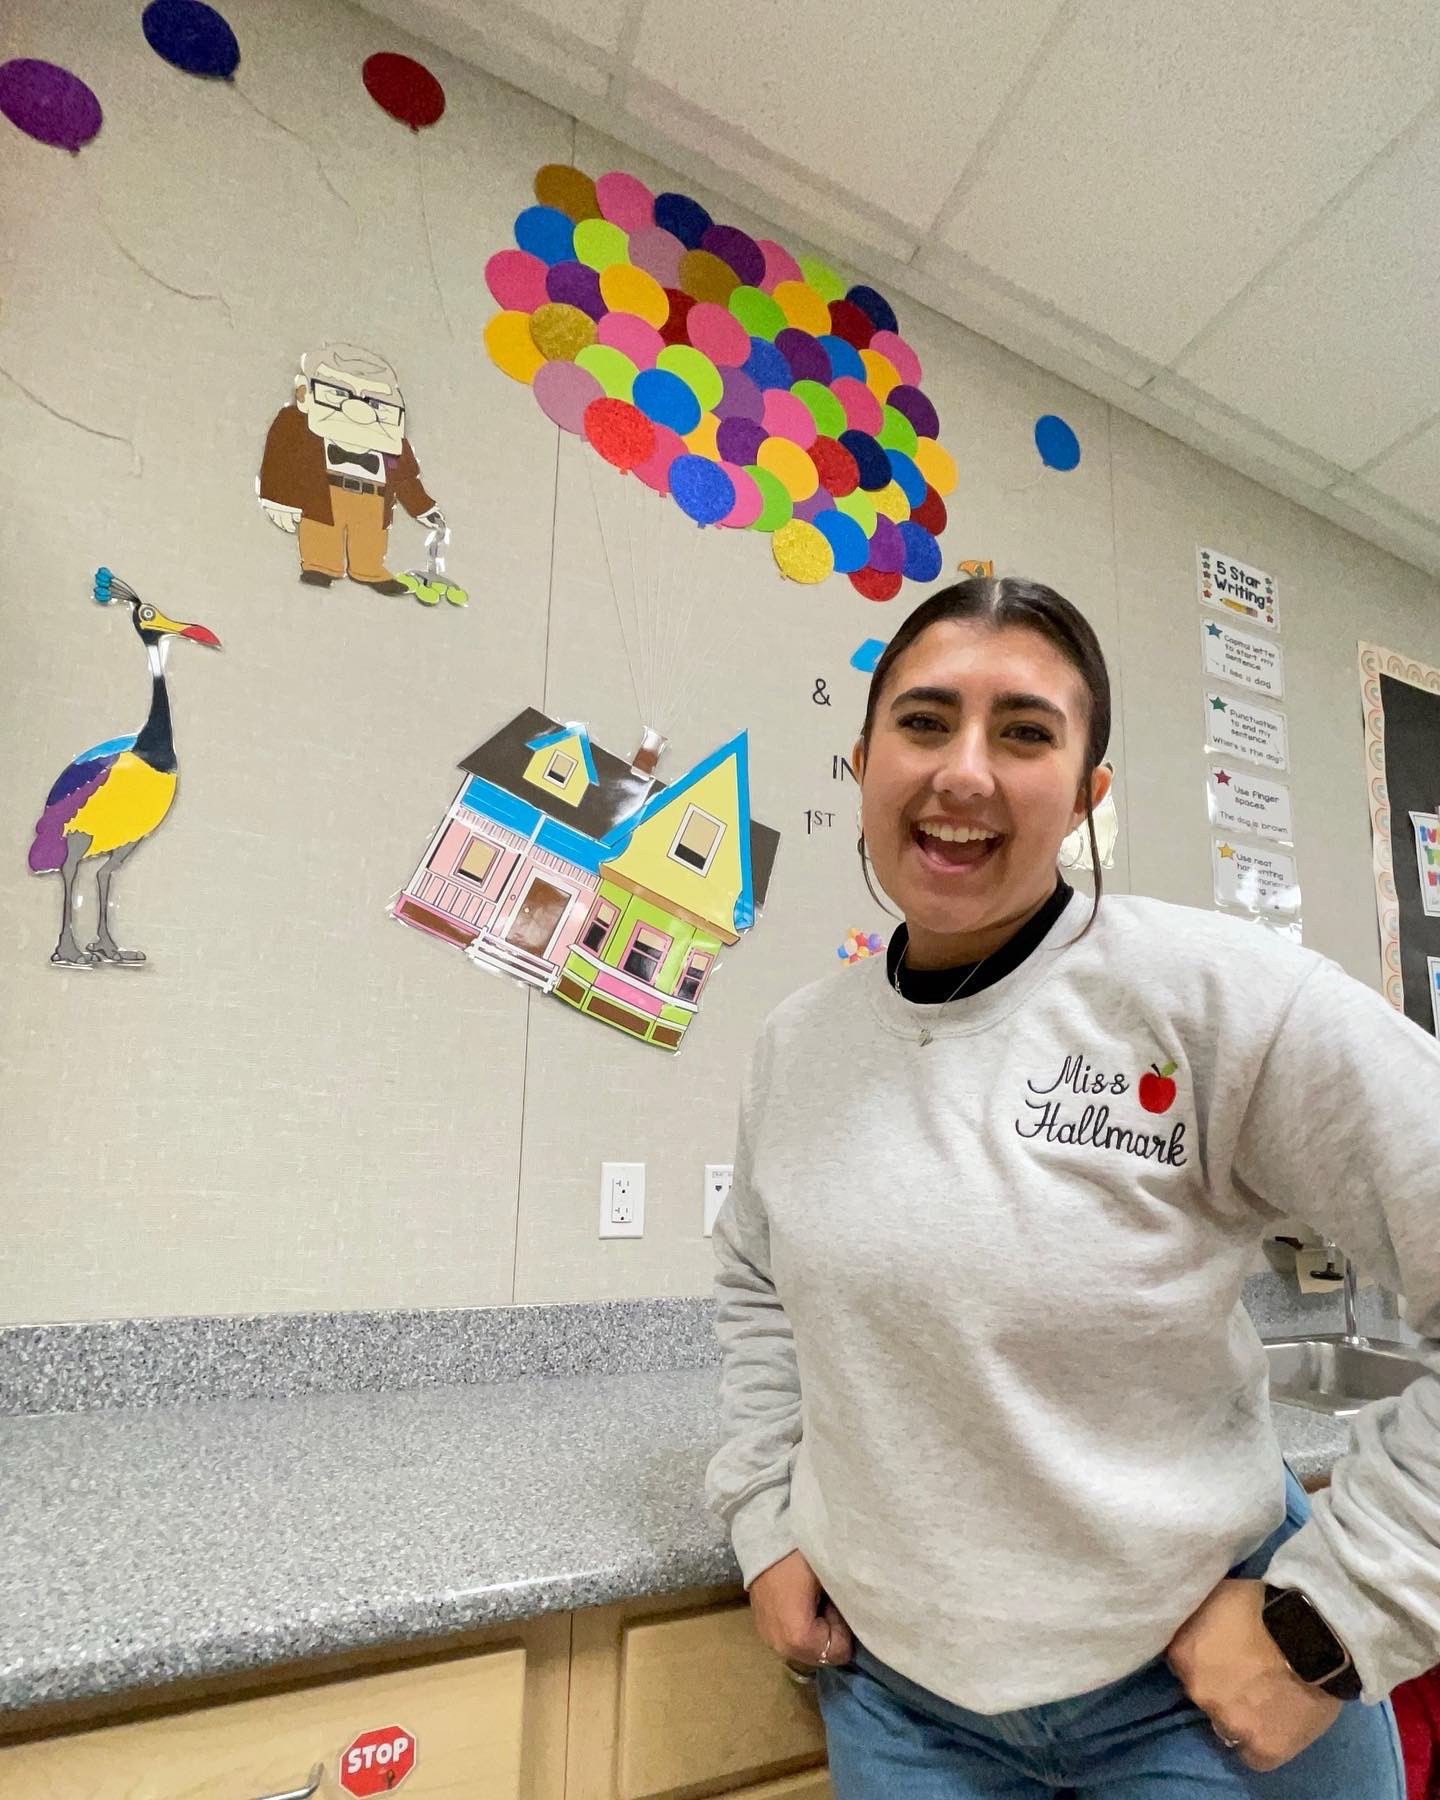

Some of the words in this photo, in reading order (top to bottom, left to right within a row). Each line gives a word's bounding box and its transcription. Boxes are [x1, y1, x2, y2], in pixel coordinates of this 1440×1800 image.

[1216, 560, 1227, 575] 5
[1229, 565, 1262, 589] Star
[1213, 574, 1266, 610] Writing
[812, 678, 831, 706] &
[1233, 784, 1250, 797] Use
[1234, 796, 1265, 810] spaces
[1027, 1054, 1130, 1095] Miss
[1015, 1099, 1188, 1167] Hallmark
[347, 1737, 409, 1774] STOP
